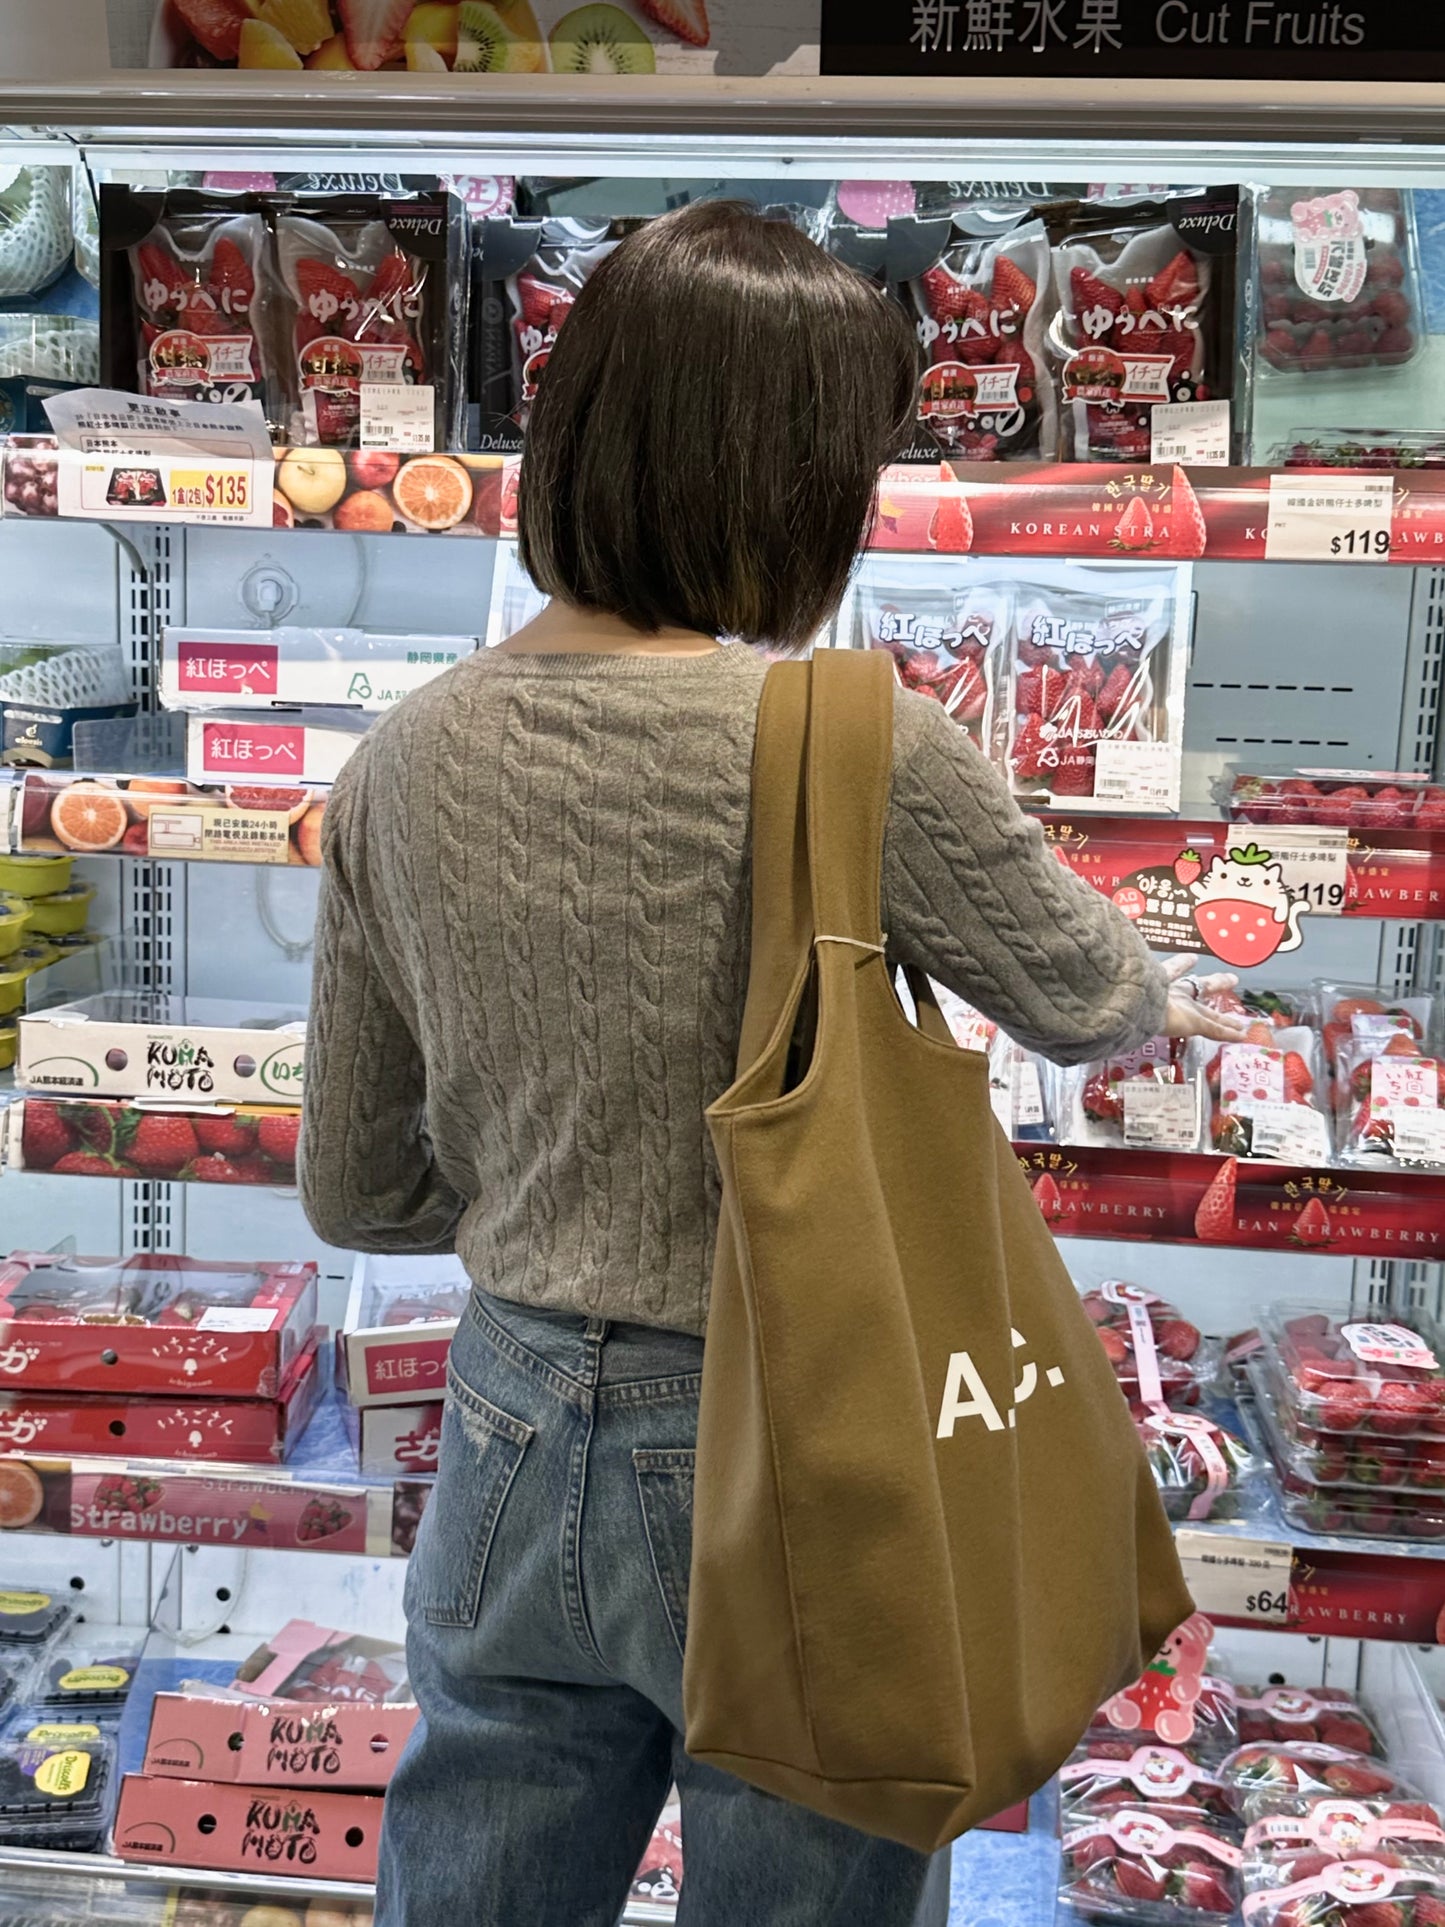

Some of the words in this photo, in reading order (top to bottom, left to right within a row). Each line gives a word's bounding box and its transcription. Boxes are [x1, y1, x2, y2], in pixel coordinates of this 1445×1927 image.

[909, 0, 1123, 54] 新鮮水果
[1155, 0, 1231, 44] Cut
[1245, 0, 1366, 46] Fruits
[389, 218, 444, 236] Deluxe
[1179, 213, 1236, 234] Deluxe
[213, 346, 246, 361] イチゴ
[366, 354, 399, 370] イチゴ
[979, 375, 1012, 390] イチゴ
[1128, 364, 1165, 381] イチゴ
[479, 434, 524, 450] Deluxe
[898, 442, 939, 459] eluxe
[205, 474, 247, 507] $135
[1104, 473, 1172, 501] 한국딸기
[1010, 521, 1100, 537] KOREAN
[1330, 529, 1390, 555] $119
[879, 610, 992, 648] 紅ほっぺ
[1032, 614, 1144, 654] 紅ほっぺ
[186, 656, 271, 680] 紅ほっぺ
[211, 737, 297, 760] 紅ほっぺ
[147, 1039, 214, 1068] KUMA
[147, 1067, 215, 1092] MOTO
[1283, 1176, 1348, 1202] 한국딸기
[1292, 1222, 1440, 1244] STRAWBERRY
[153, 1335, 229, 1363] いちごさん
[157, 1407, 234, 1435] いちごさん
[70, 1503, 249, 1540] Strawberry
[1246, 1590, 1288, 1614] $64
[270, 1717, 342, 1746] KUMA
[267, 1745, 341, 1774] MOTO
[246, 1800, 320, 1835] KUMA
[241, 1832, 318, 1865] MOTO
